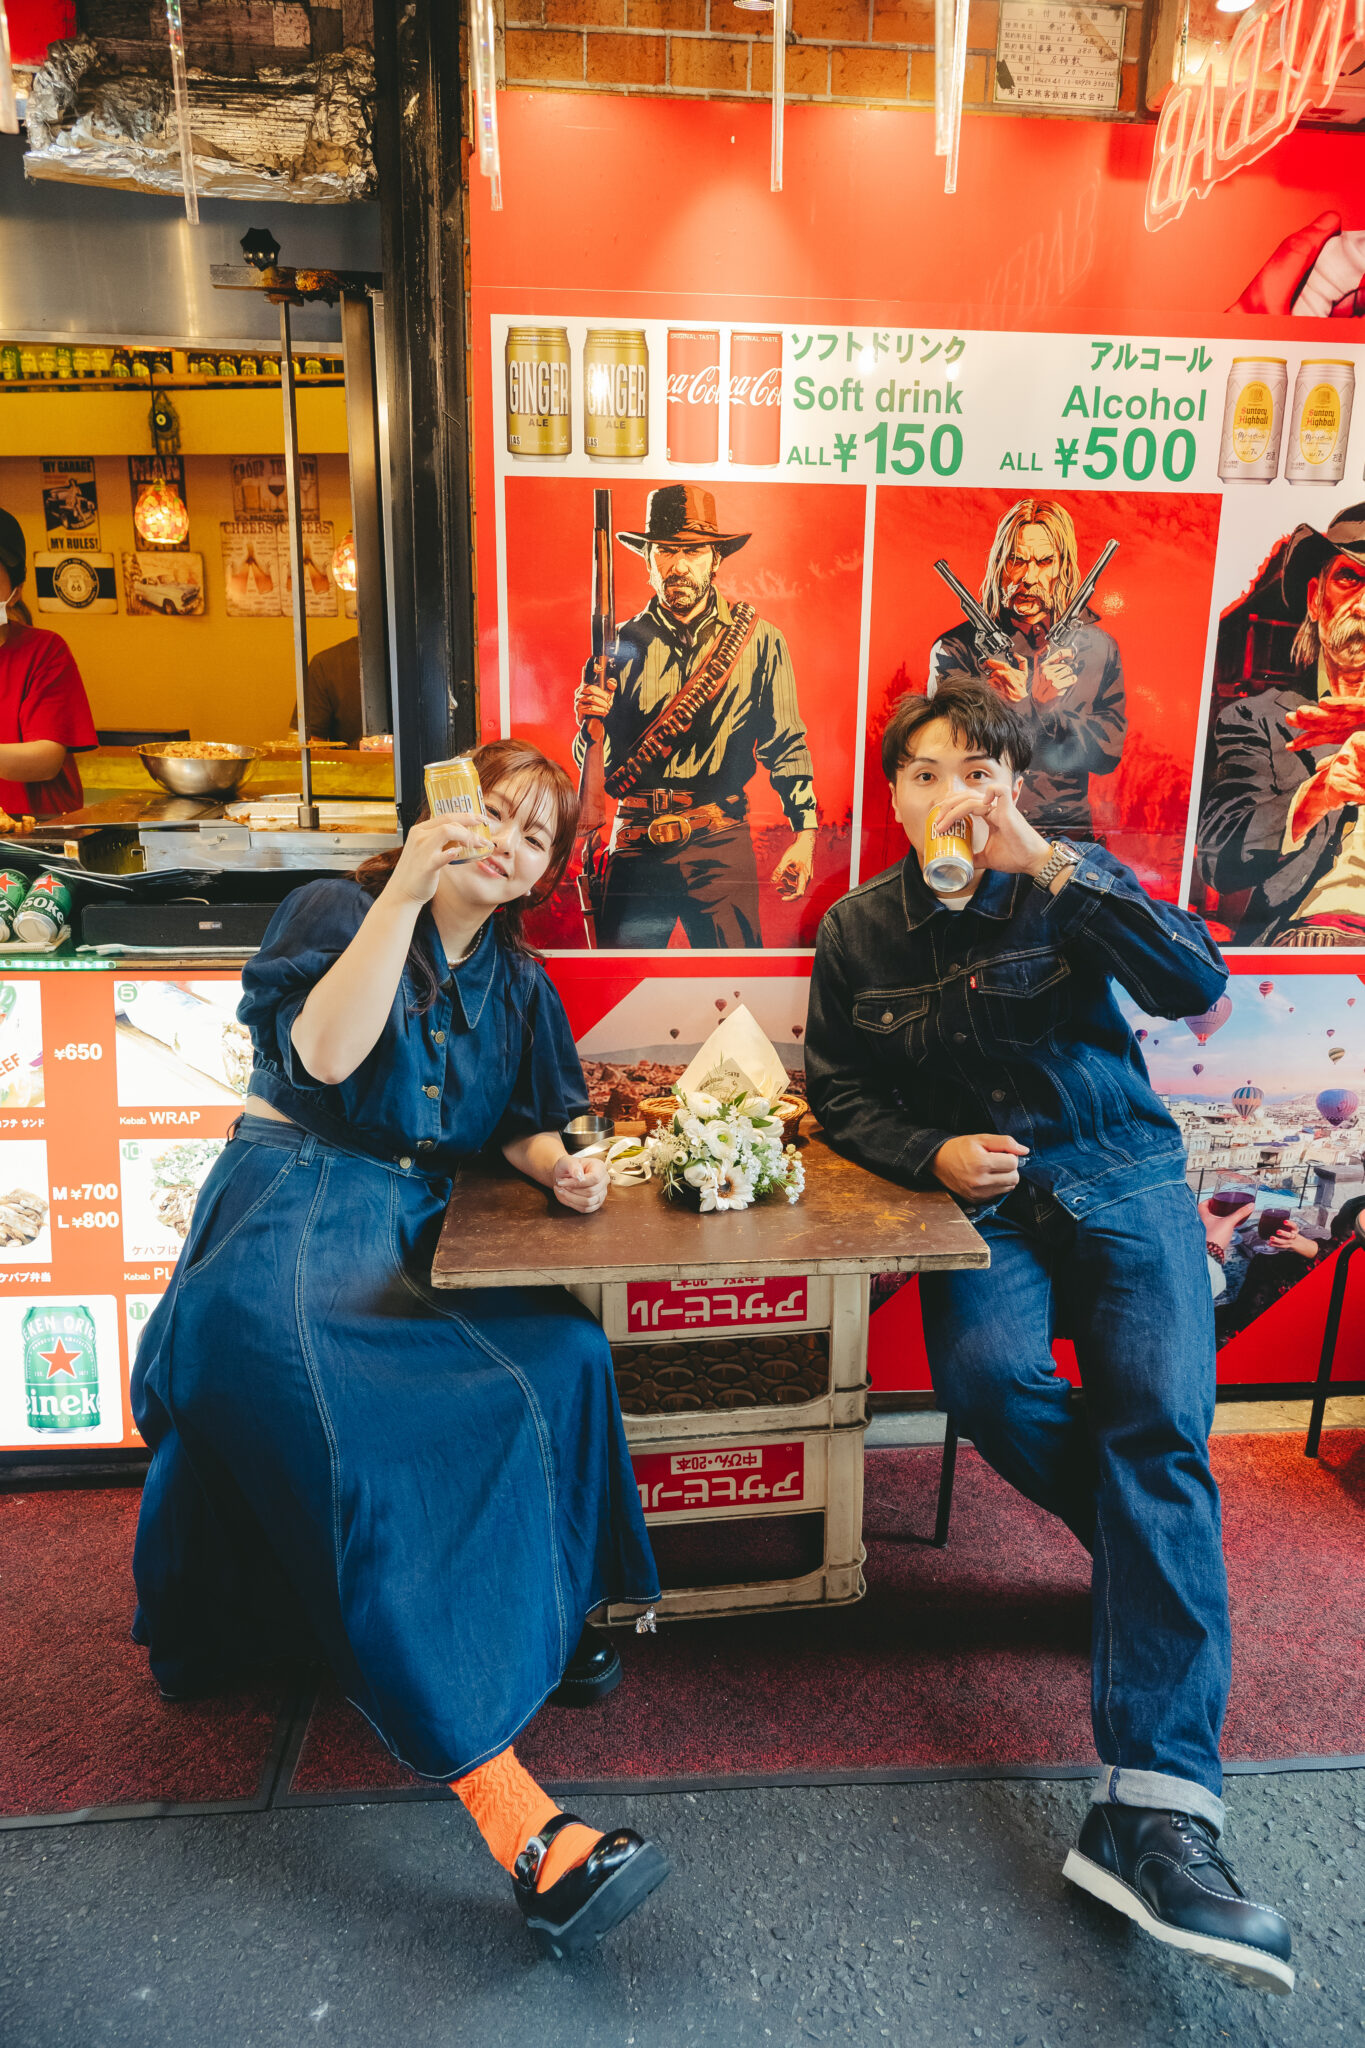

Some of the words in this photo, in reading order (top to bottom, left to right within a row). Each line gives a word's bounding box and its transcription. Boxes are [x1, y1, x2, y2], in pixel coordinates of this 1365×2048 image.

[791, 331, 967, 365] ソフトドリンク
[1090, 341, 1213, 373] アルコール
[508, 360, 568, 416] GINGER
[792, 376, 864, 411] Soft
[876, 379, 964, 415] drink
[1061, 385, 1207, 422] Alcohol
[528, 418, 549, 427] ALE
[606, 421, 626, 429] ALE
[786, 446, 832, 466] ALL
[834, 421, 964, 476] ¥150
[1000, 452, 1043, 471] ALL
[1054, 427, 1196, 482] ¥500
[43, 461, 55, 473] MY
[223, 522, 274, 534] CHEERS
[280, 521, 331, 534] CEERS
[50, 538, 63, 549] MY
[66, 538, 98, 549] RULES!
[71, 584, 82, 592] 66
[54, 1043, 103, 1060] ¥650
[120, 1116, 147, 1125] Kebab
[149, 1111, 201, 1125] WRAP
[52, 1186, 68, 1200] M
[71, 1183, 118, 1200] ¥700
[58, 1214, 69, 1228] L
[72, 1211, 119, 1228] ¥800
[124, 1273, 151, 1281] Kebab
[631, 1289, 804, 1326] アサヒビール
[675, 1452, 758, 1473] 中びん・20本
[638, 1471, 800, 1507] アサヒビール
